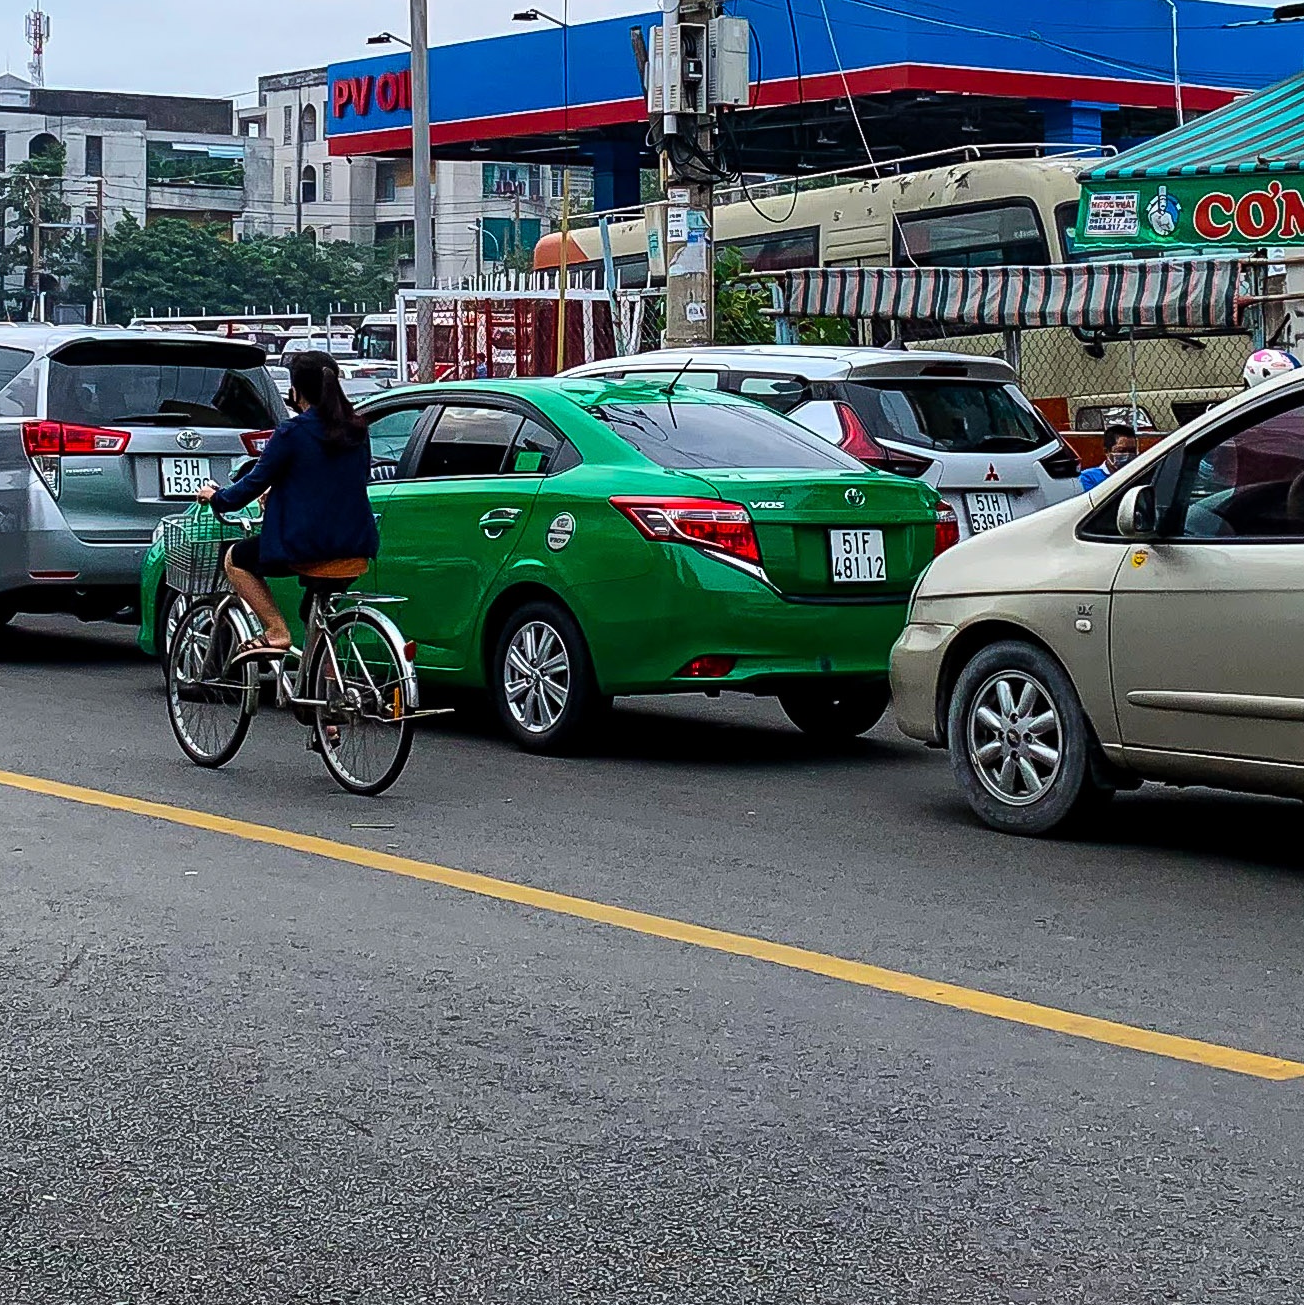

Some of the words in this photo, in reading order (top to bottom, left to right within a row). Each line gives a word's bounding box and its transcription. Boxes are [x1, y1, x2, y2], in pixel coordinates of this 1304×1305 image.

[332, 75, 373, 118] PV
[174, 459, 200, 477] 51H
[749, 501, 785, 509] VIOS
[975, 493, 1001, 512] 51H
[842, 532, 871, 555] 51F
[834, 556, 885, 580] 481.12
